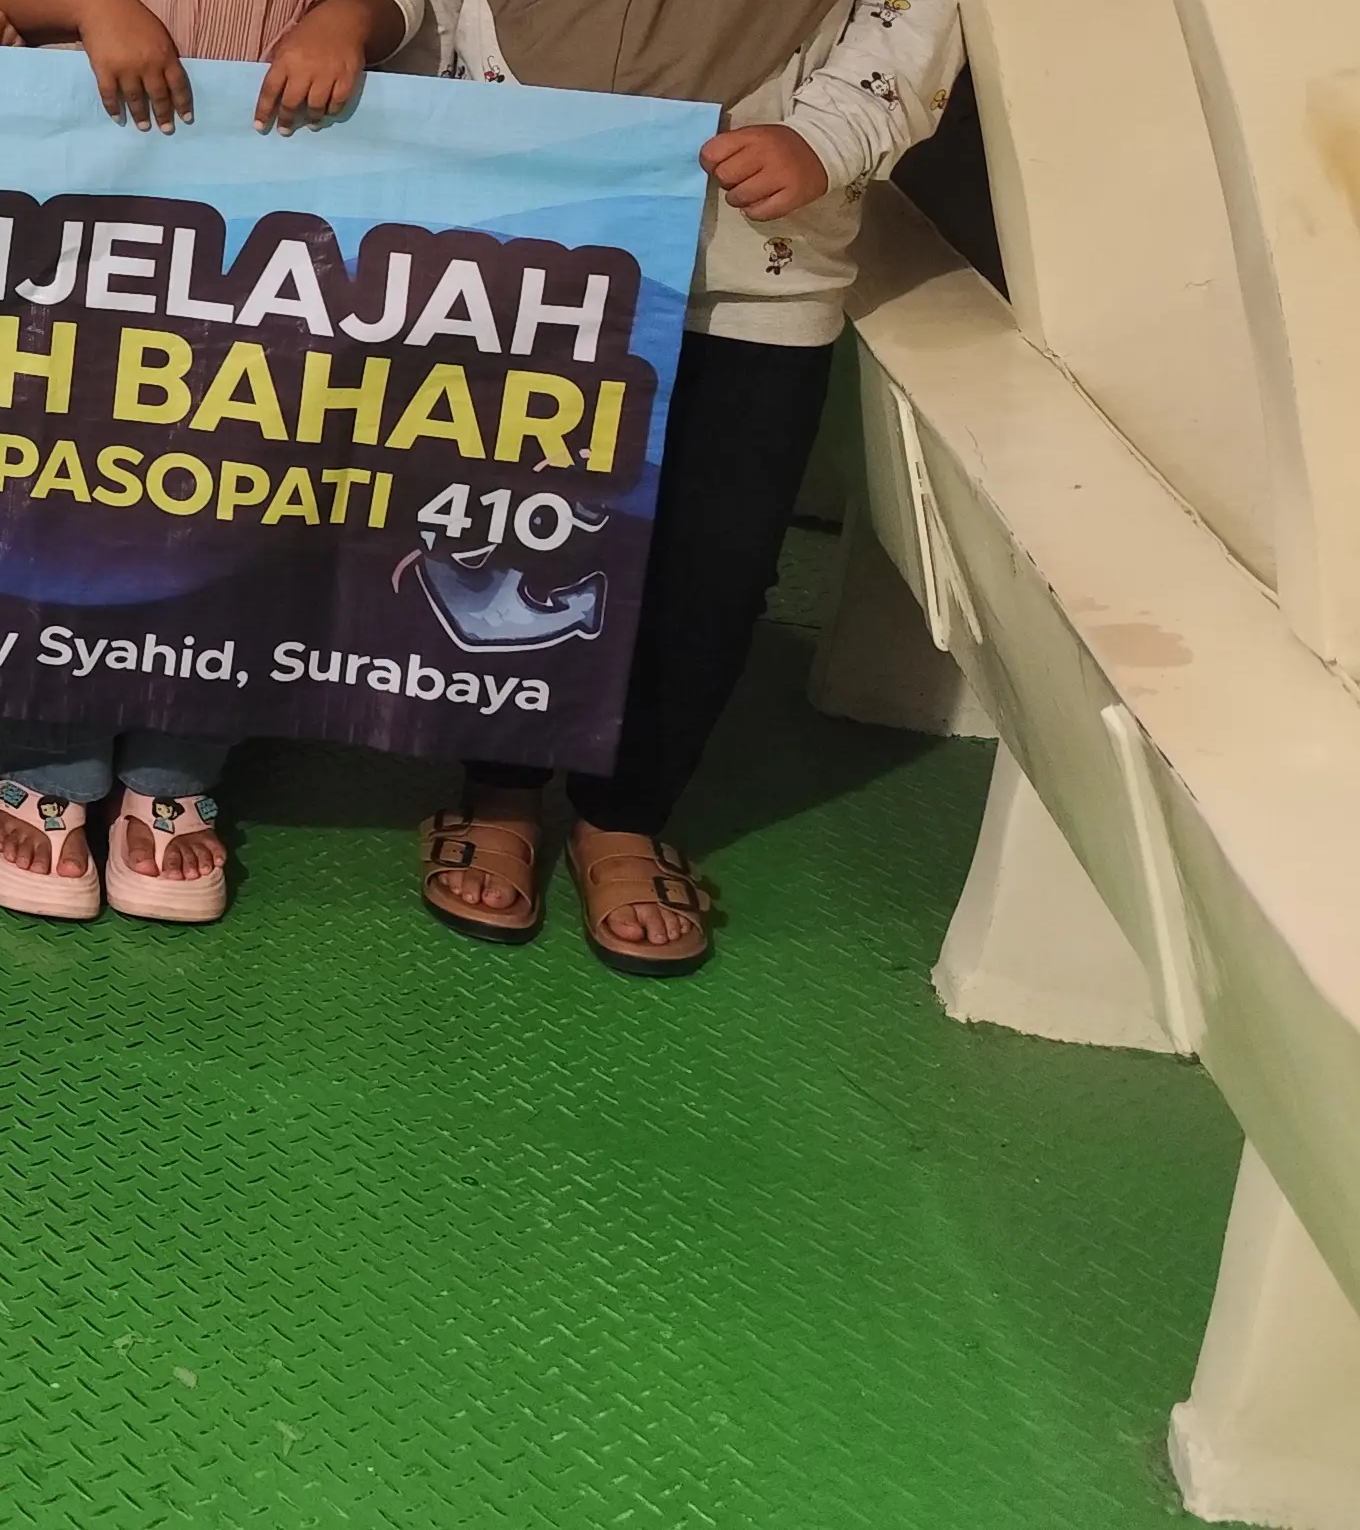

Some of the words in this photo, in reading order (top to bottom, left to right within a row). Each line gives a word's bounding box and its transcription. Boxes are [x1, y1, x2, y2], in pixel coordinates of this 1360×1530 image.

[112, 327, 627, 474] BAHARI
[417, 483, 574, 552] 410
[36, 625, 248, 689] Syahid,
[269, 641, 551, 715] Surabaya
